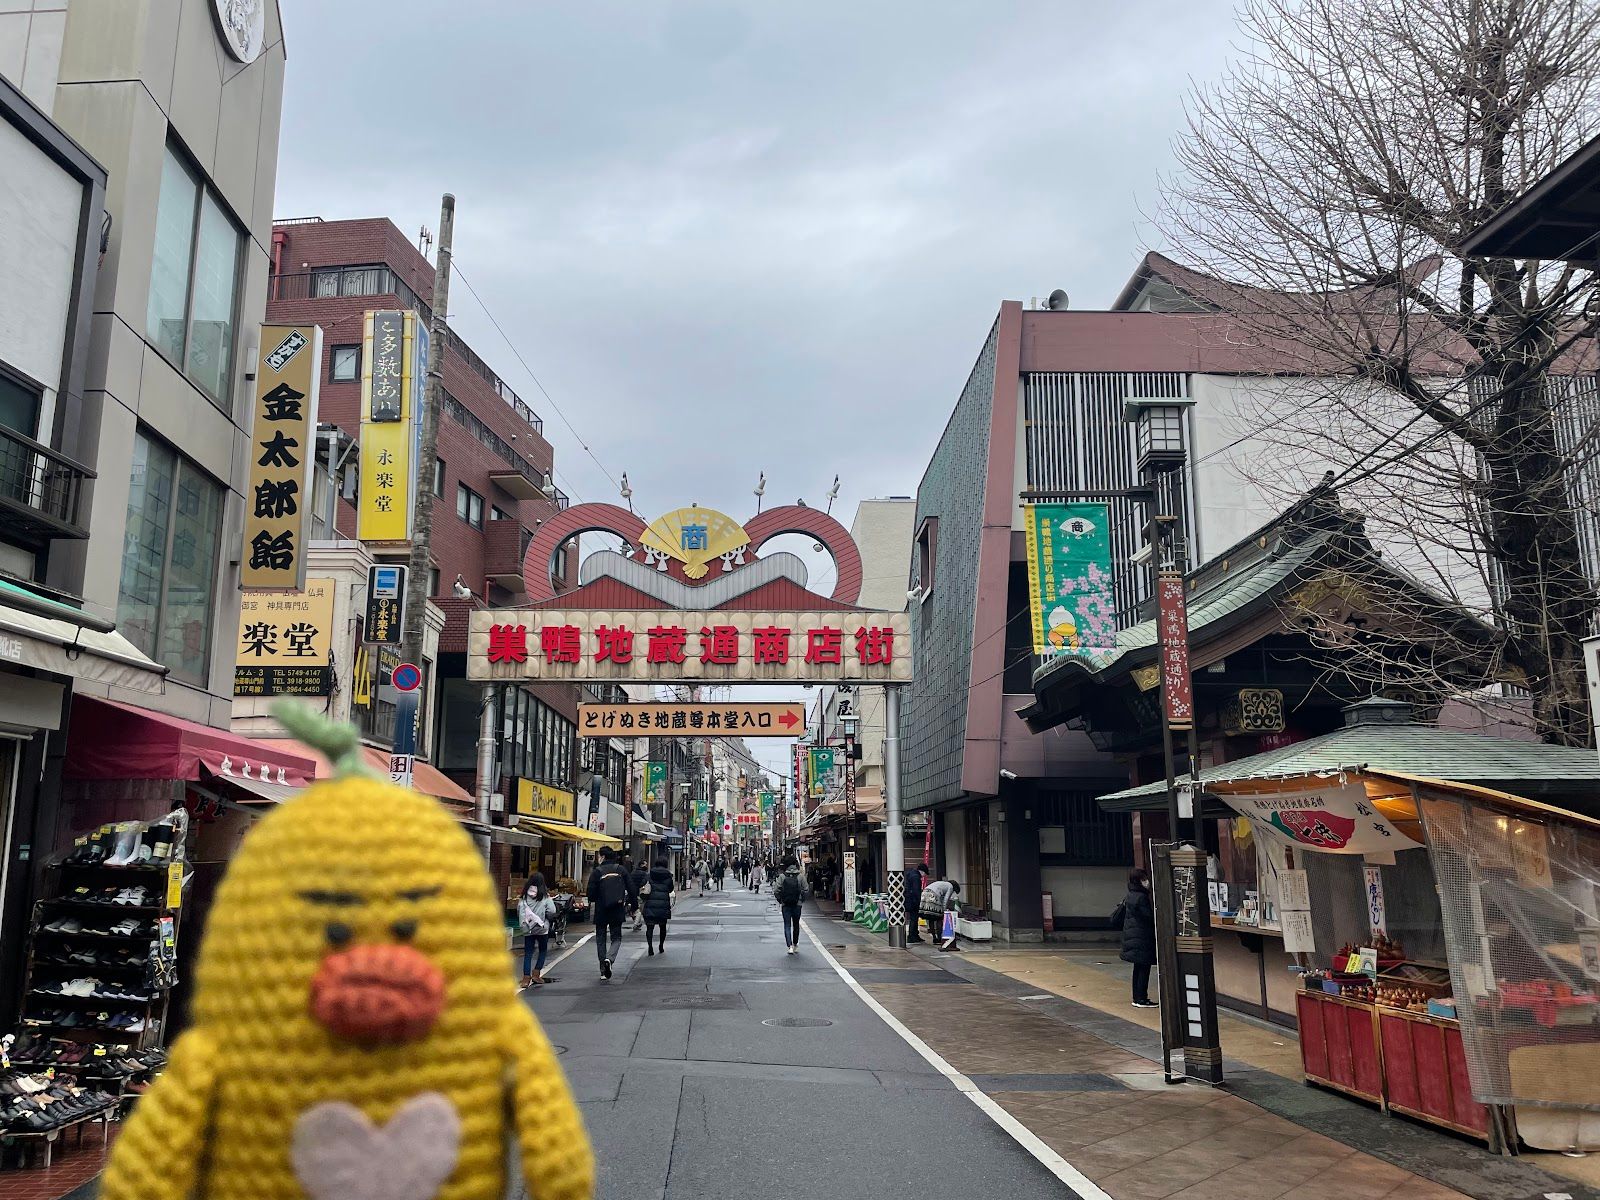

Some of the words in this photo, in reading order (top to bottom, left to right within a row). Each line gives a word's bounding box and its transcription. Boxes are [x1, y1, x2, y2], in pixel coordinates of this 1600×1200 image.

[249, 382, 306, 571] 金太郎飴
[374, 448, 394, 513] 永楽堂
[681, 523, 708, 551] 商
[240, 621, 319, 657] 楽堂
[487, 623, 895, 666] 巣鴨地蔵通商店街
[1166, 609, 1183, 689] 巣鴨地蔵通り
[272, 685, 284, 693] TEL
[273, 677, 285, 685] TEL
[583, 709, 772, 731] とげぬき地蔵尊本堂入口
